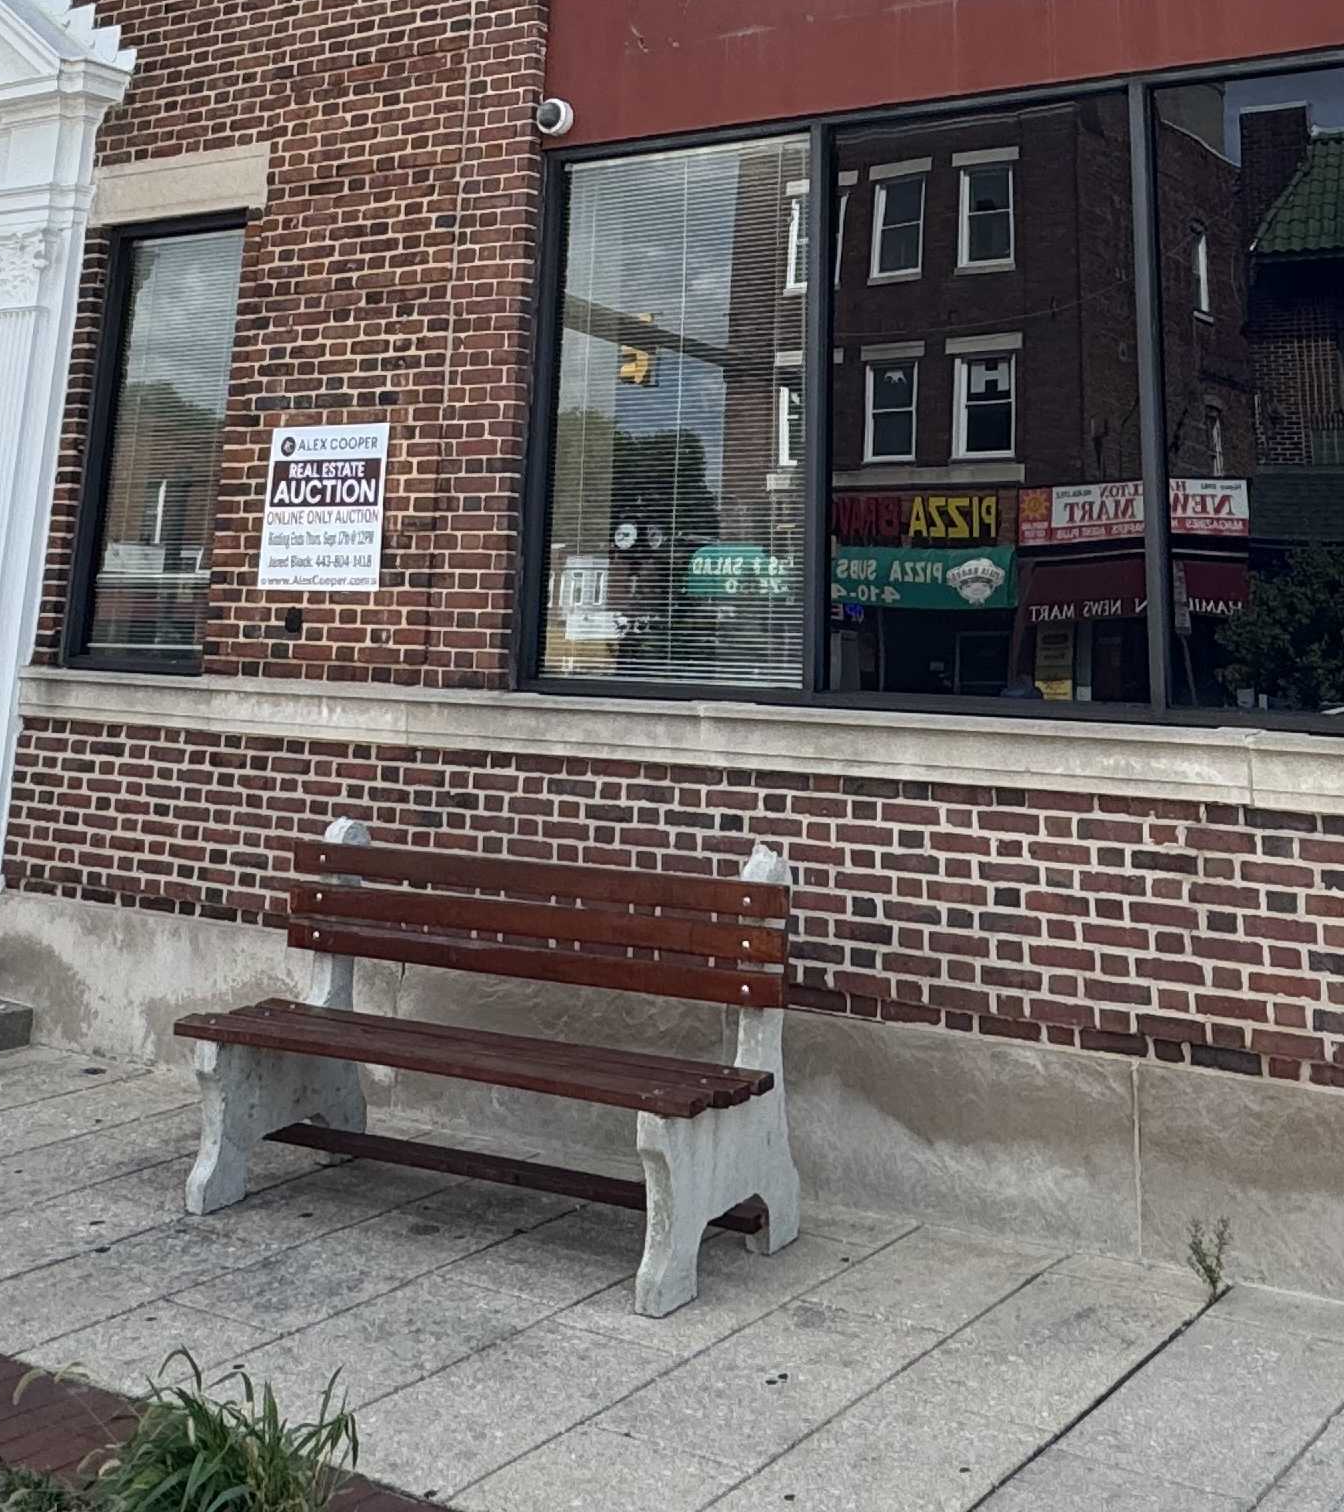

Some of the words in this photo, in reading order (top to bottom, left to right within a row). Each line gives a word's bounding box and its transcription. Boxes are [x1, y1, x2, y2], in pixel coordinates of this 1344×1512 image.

[297, 438, 329, 451] ALEX
[330, 436, 379, 450] COOPER
[289, 462, 320, 478] REAL
[322, 461, 365, 478] ESTATE
[273, 478, 376, 504] AUCTION
[267, 510, 305, 525] ONLINE
[307, 510, 333, 524] ONLY
[334, 508, 379, 524] AUCTION
